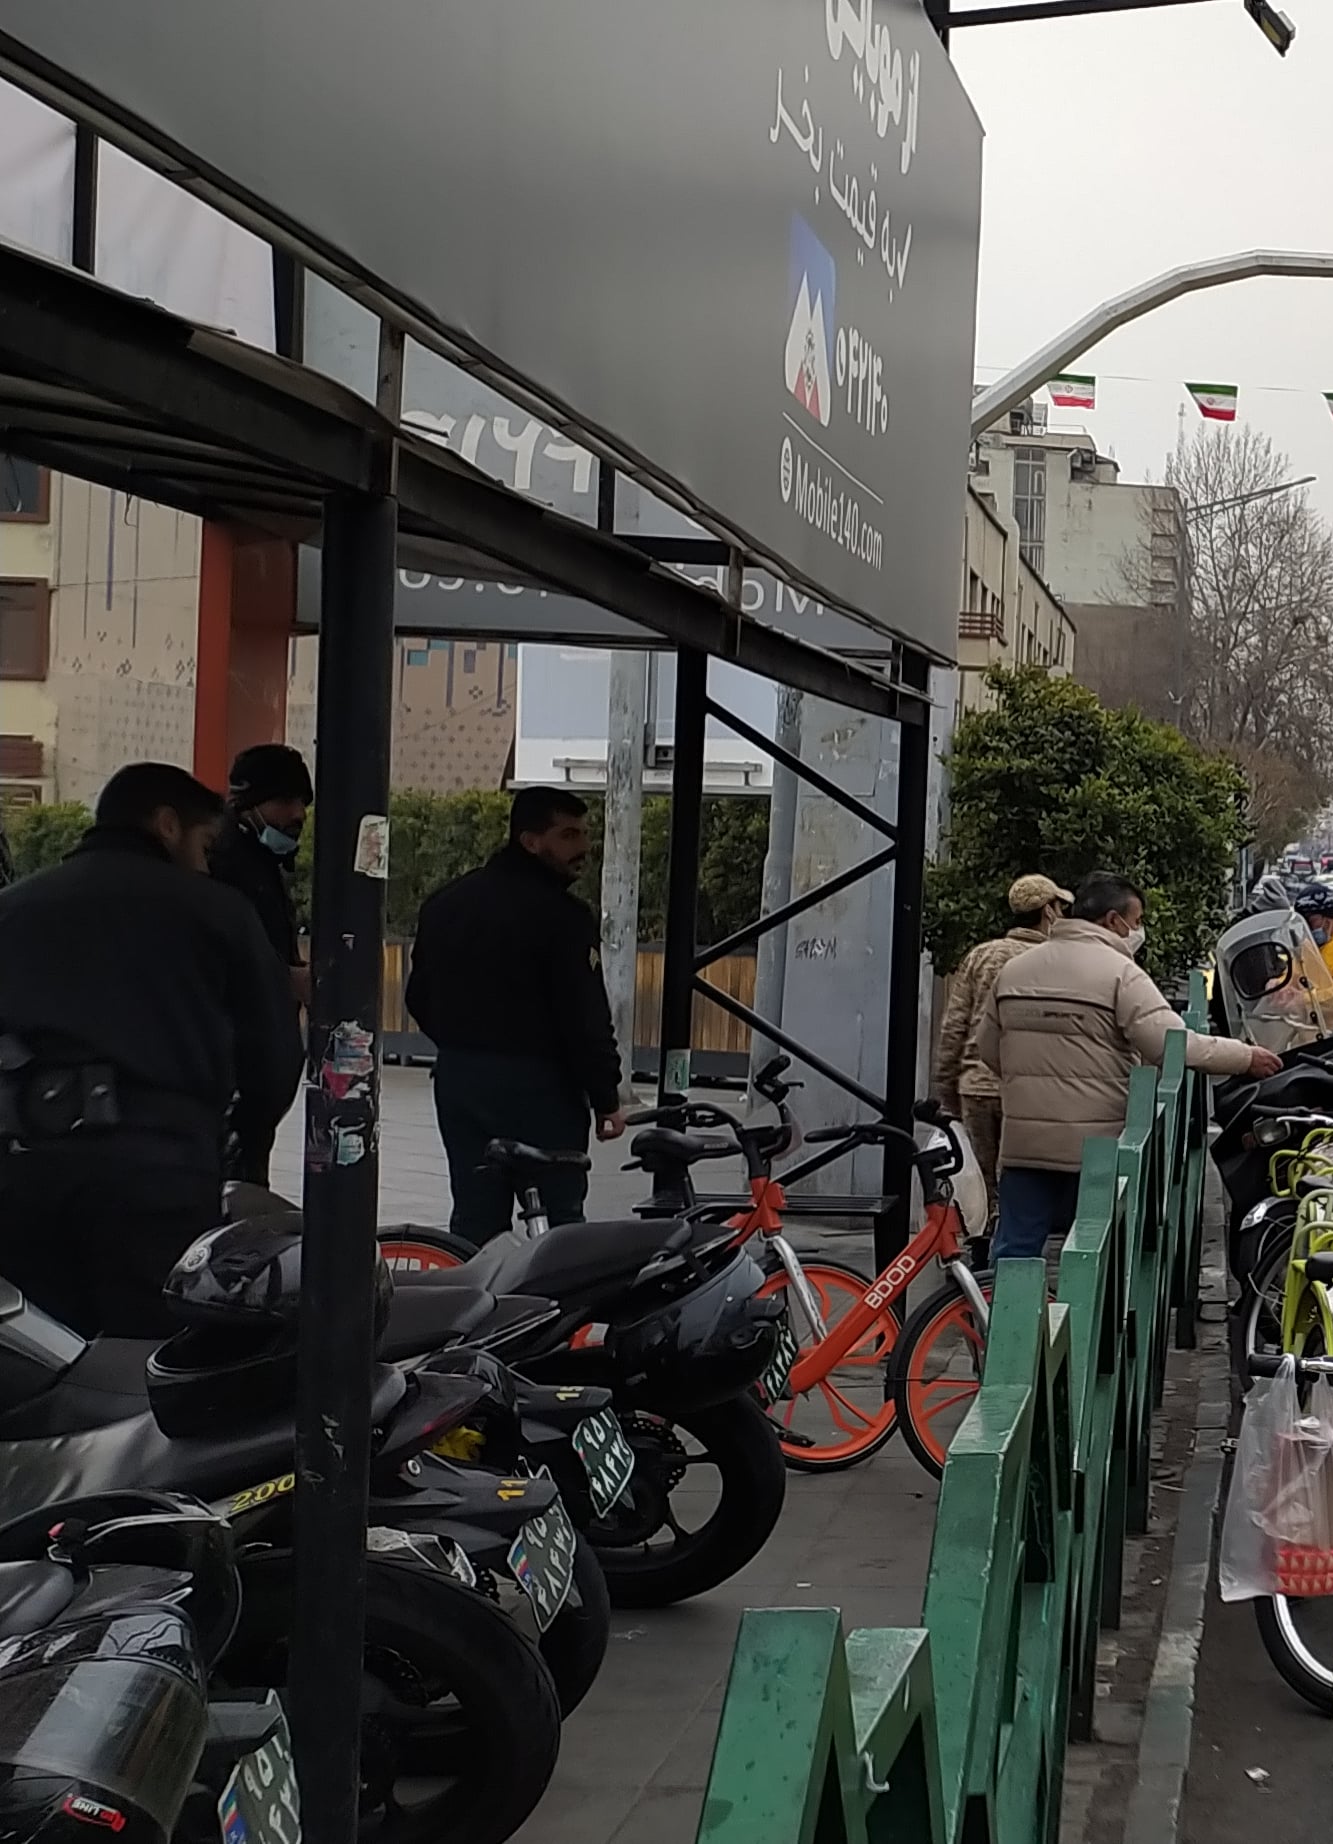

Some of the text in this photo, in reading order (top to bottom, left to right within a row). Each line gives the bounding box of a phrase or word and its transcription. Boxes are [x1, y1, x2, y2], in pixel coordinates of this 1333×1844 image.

[769, 64, 823, 205] بخر
[829, 138, 878, 267] قیمت
[795, 455, 883, 572] Mobile140.com
